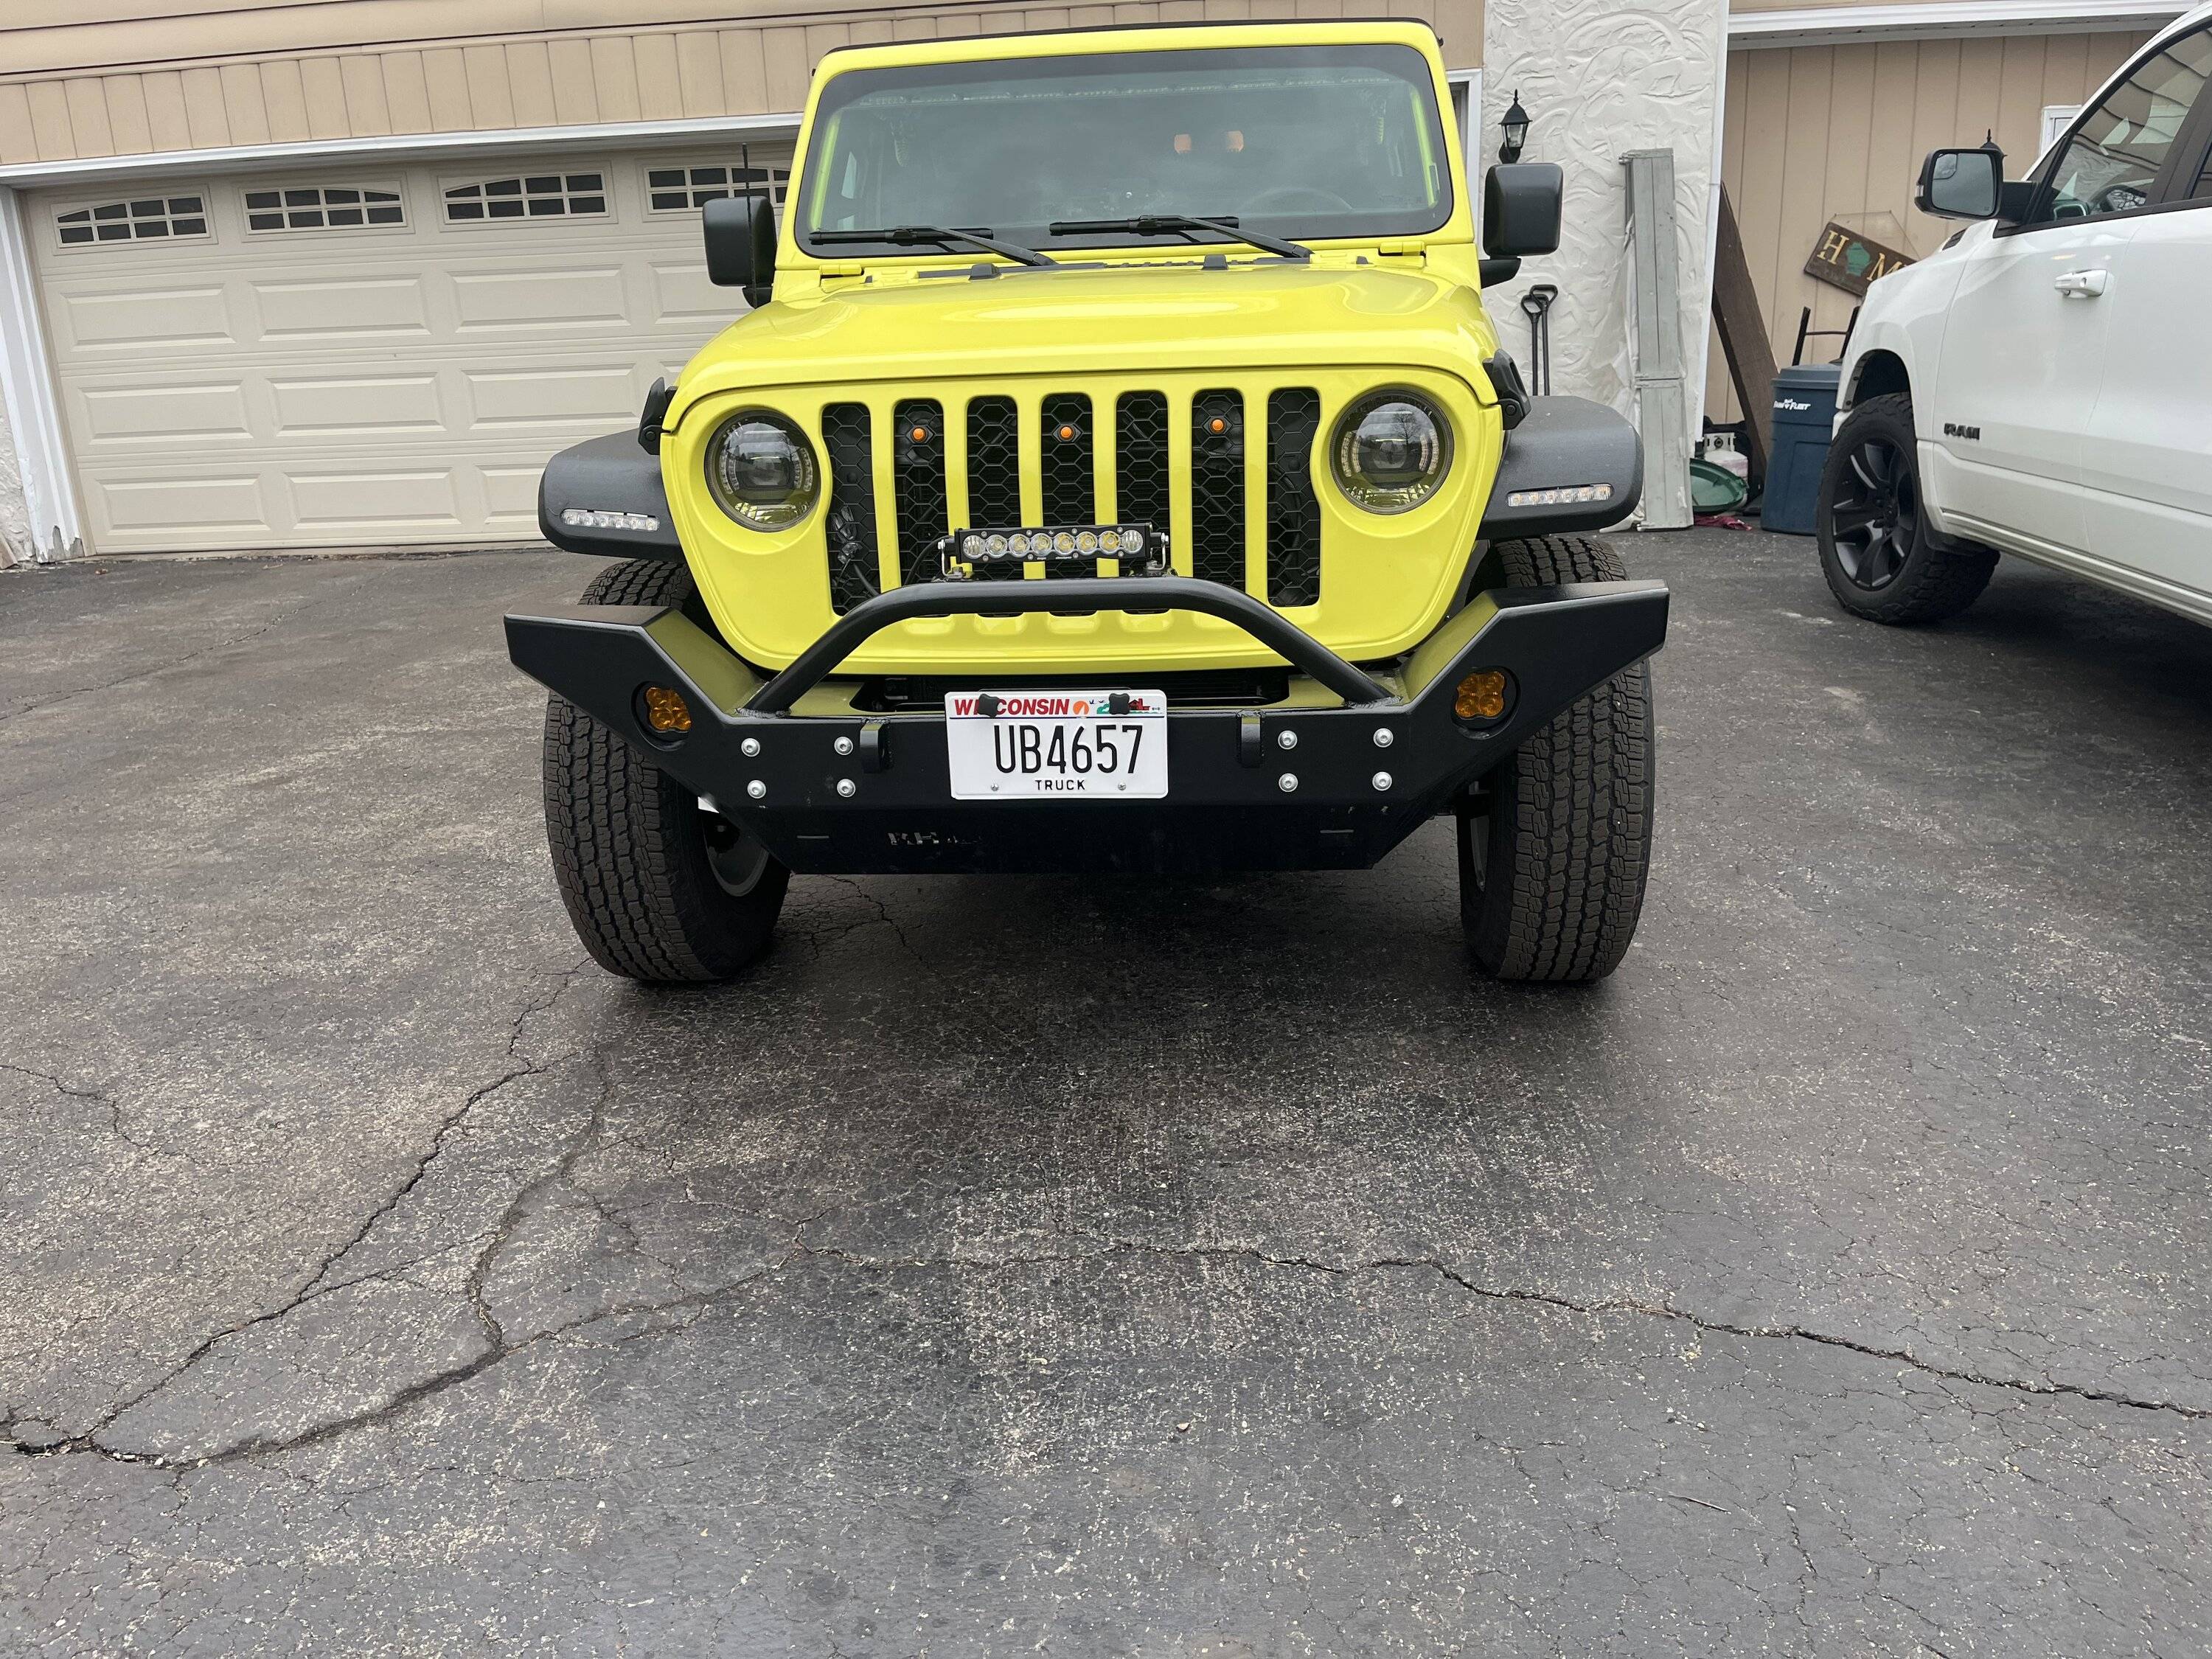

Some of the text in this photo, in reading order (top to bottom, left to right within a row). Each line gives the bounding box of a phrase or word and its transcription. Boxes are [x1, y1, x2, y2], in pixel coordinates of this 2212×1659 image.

[1944, 423, 1980, 440] RAM
[954, 698, 1070, 715] WICONSIN
[994, 724, 1144, 774] UB4657
[1034, 779, 1086, 791] TRUCK
